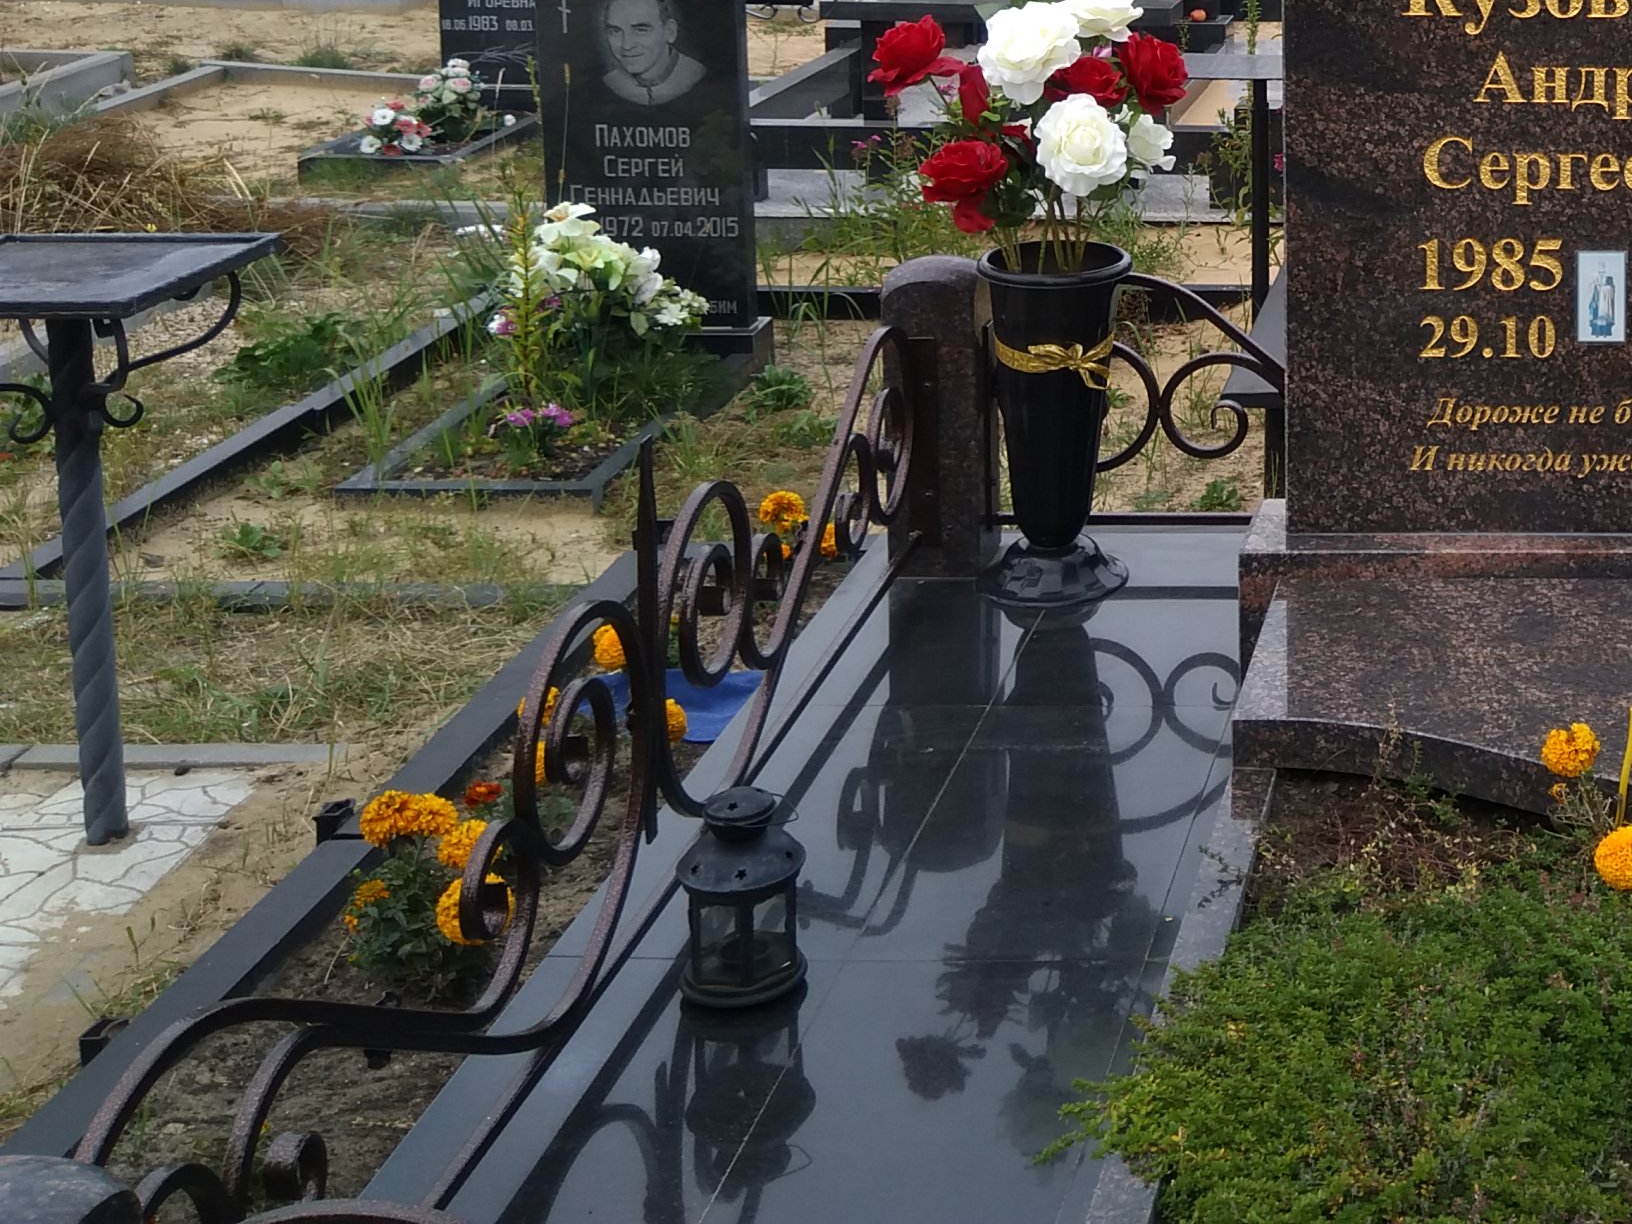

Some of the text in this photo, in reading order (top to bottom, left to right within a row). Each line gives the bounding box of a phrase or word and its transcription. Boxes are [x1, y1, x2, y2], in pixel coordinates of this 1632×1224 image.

[505, 20, 535, 32] 08.03.
[594, 124, 691, 148] ПАХОМОВ
[603, 154, 684, 177] СЕРГЕЙ
[569, 185, 720, 206] ГЕННАДЬЕВИЧ
[598, 217, 739, 237] 1972 07.04.2015
[1417, 238, 1564, 292] 1985
[1419, 315, 1556, 359] 29.10
[1427, 396, 1559, 430] Дороже
[1568, 405, 1605, 425] не
[1409, 445, 1440, 472] И
[1447, 446, 1571, 472] никогда
